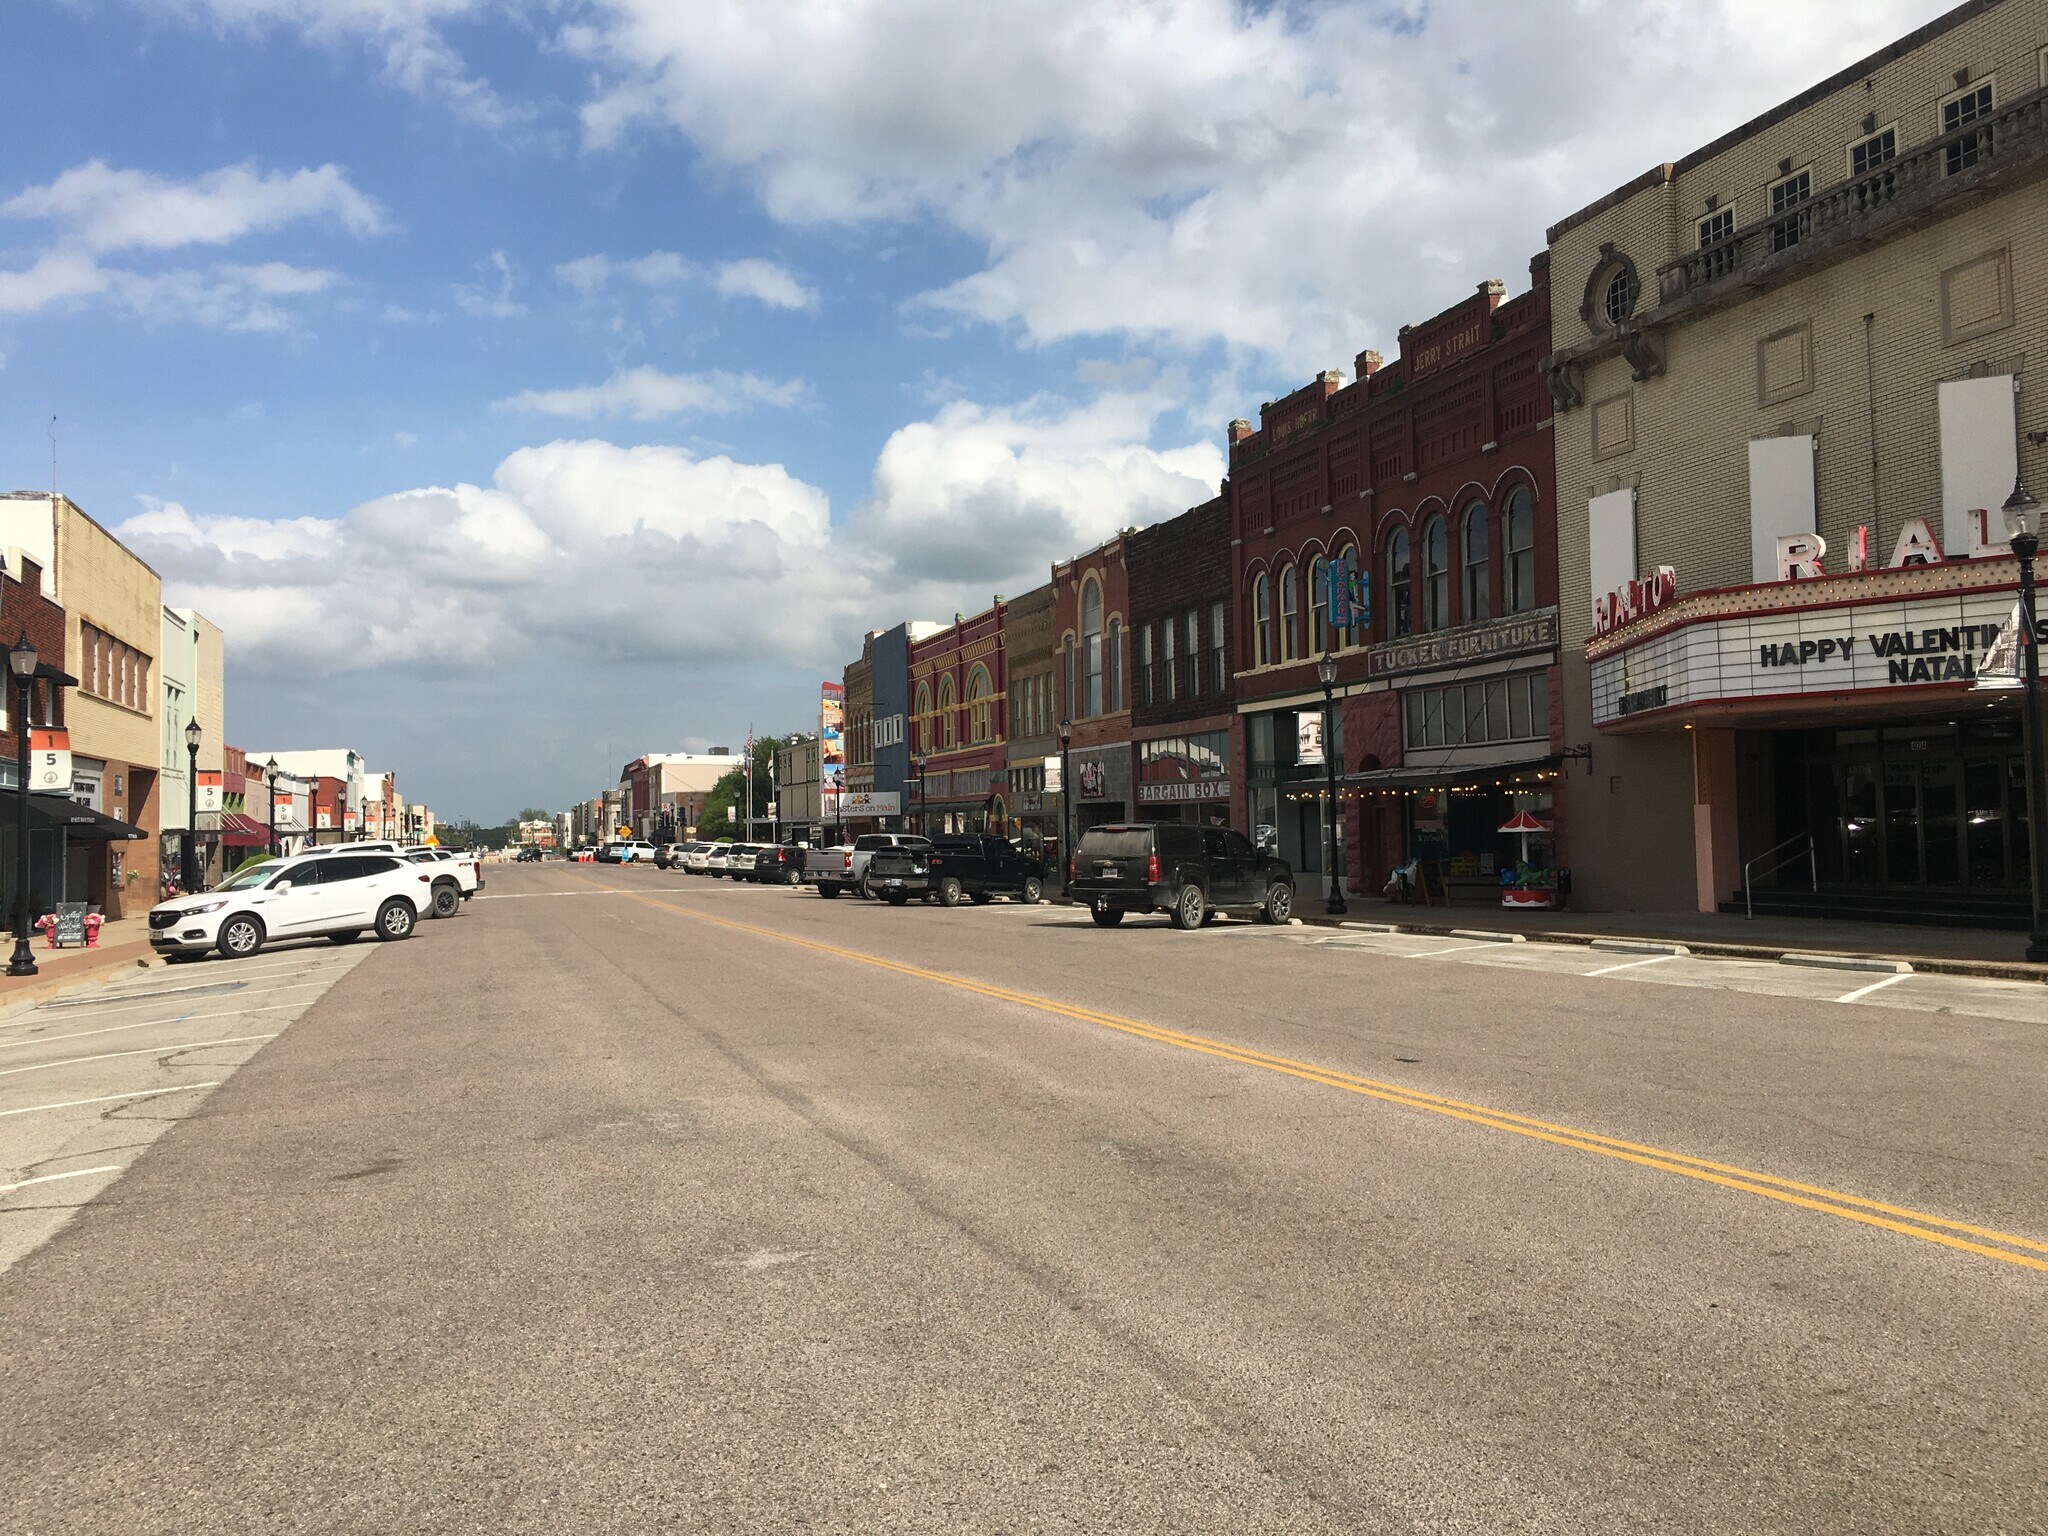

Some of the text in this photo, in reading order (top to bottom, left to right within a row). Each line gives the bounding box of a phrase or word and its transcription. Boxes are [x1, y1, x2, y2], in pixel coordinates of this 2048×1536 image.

[1414, 324, 1480, 372] JERRY STRAIT
[1594, 565, 1676, 635] RIALTO
[1375, 621, 1550, 671] TUCKER FURNITURE
[1760, 619, 2048, 668] HAPPY VALENTINS
[1889, 652, 1987, 683] NATAL
[48, 735, 53, 747] 1
[46, 753, 56, 766] 5
[206, 787, 213, 796] 5
[1139, 781, 1220, 800] BARGAIN BOX
[866, 804, 876, 812] on
[877, 803, 896, 812] Main
